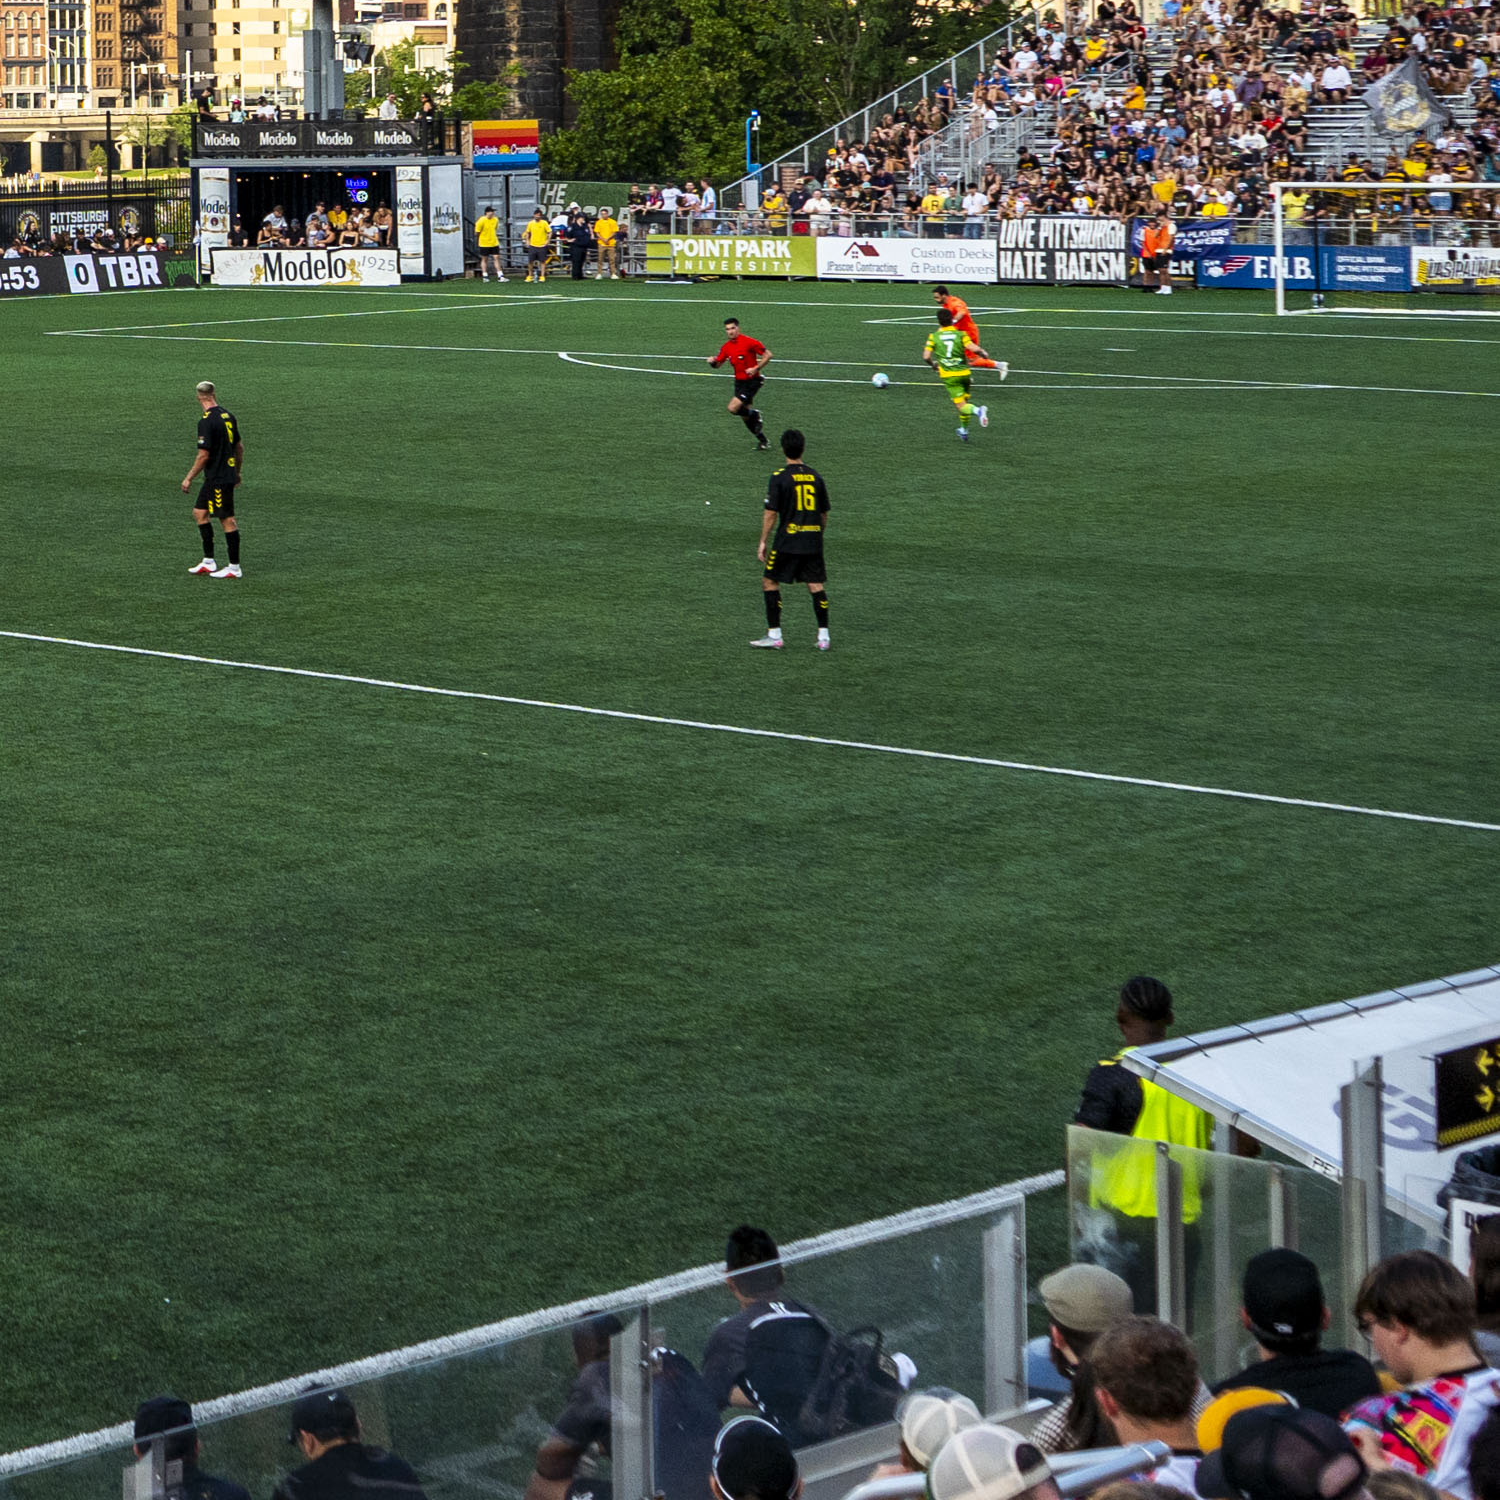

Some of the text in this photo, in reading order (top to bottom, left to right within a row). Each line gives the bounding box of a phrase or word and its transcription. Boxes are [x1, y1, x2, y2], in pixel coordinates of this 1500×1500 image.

[204, 132, 240, 146] Modelo
[259, 132, 297, 146] Modelo
[316, 131, 353, 145] Modelo
[374, 130, 412, 145] Modelo
[50, 211, 109, 225] PITTSBURGH
[1000, 218, 1126, 249] LOVE PITTSBURGH
[672, 239, 792, 258] POINT PARK
[911, 247, 995, 259] Custom Decks
[99, 255, 162, 288] TBR
[263, 251, 347, 283] Modelo
[361, 255, 396, 272] 1925
[911, 263, 996, 276] & Patio Covers
[1000, 251, 1047, 280] HATE
[1055, 251, 1127, 280] RACISM
[943, 340, 955, 358] 7
[794, 484, 817, 511] 16
